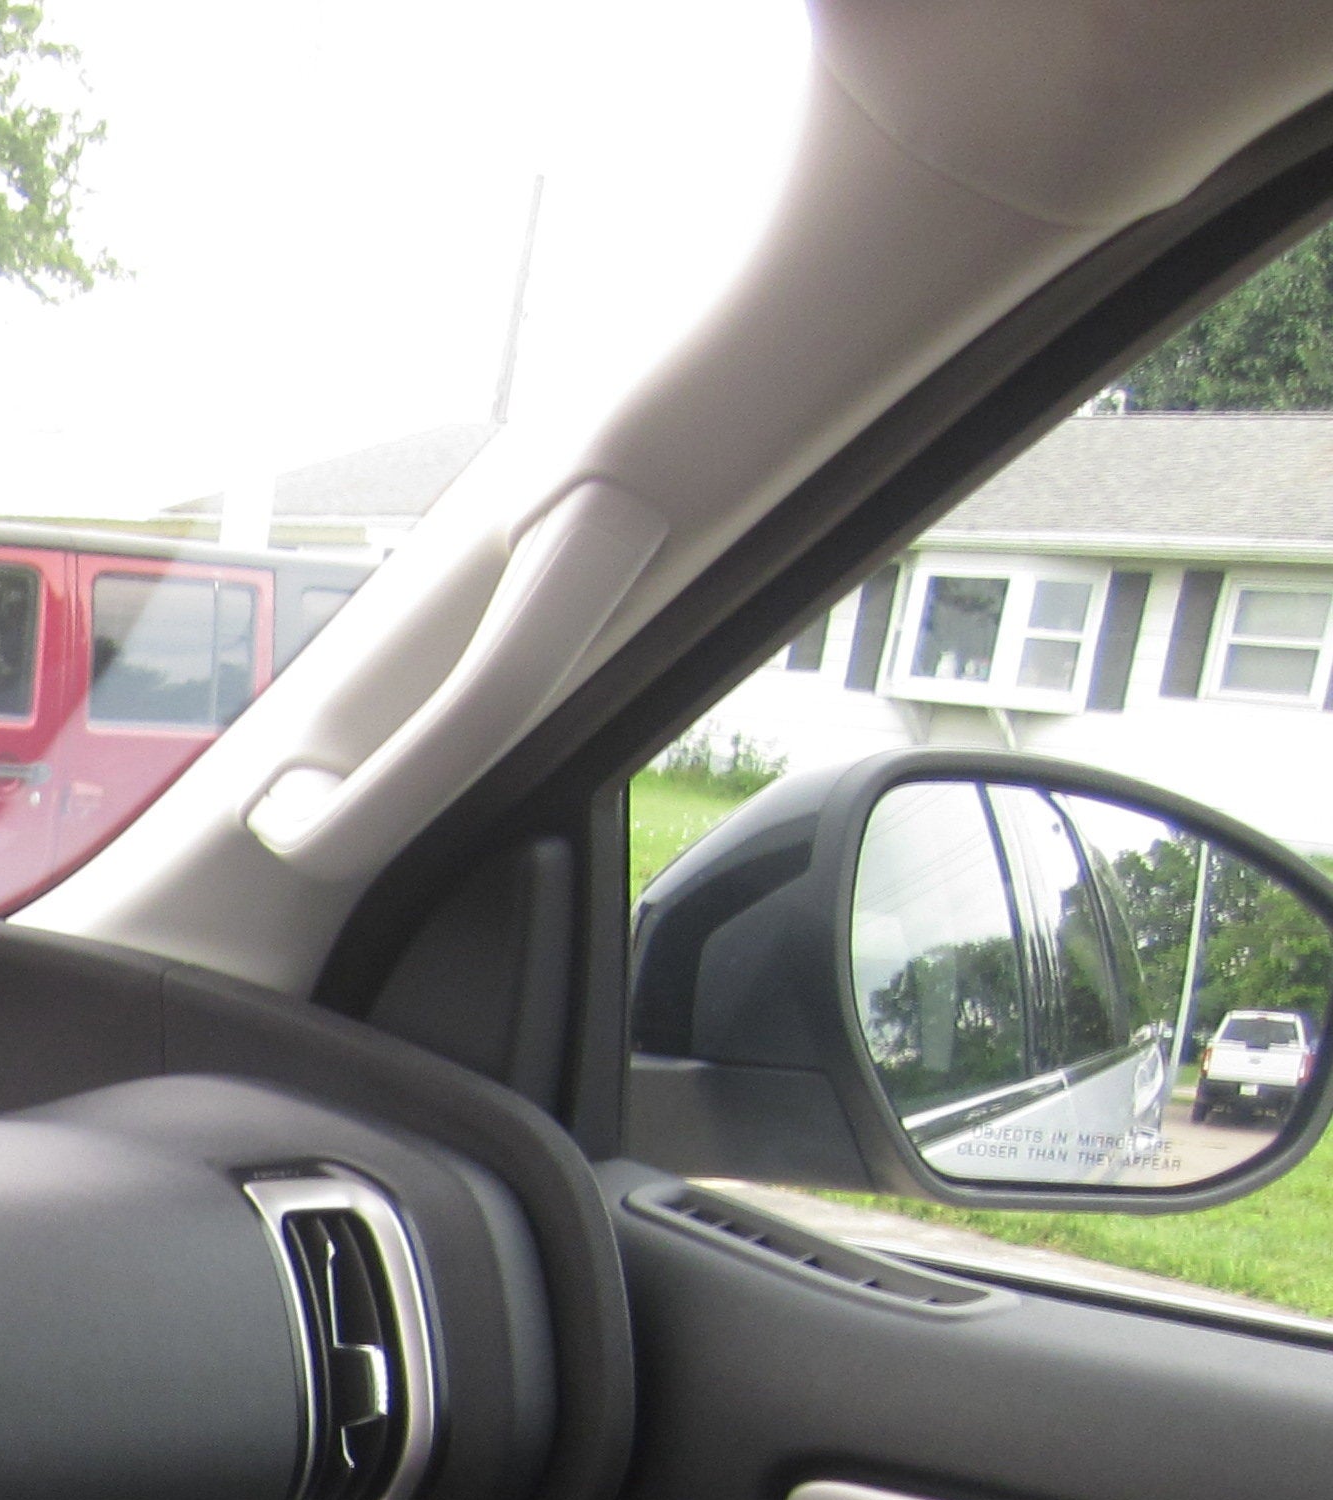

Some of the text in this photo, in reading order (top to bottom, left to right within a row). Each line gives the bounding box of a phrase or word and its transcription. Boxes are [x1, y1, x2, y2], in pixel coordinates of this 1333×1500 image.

[973, 1123, 1042, 1144] OBJECTS
[1051, 1130, 1067, 1145] IN
[957, 1141, 1181, 1172] CLOSER THAN THEY APPEAR
